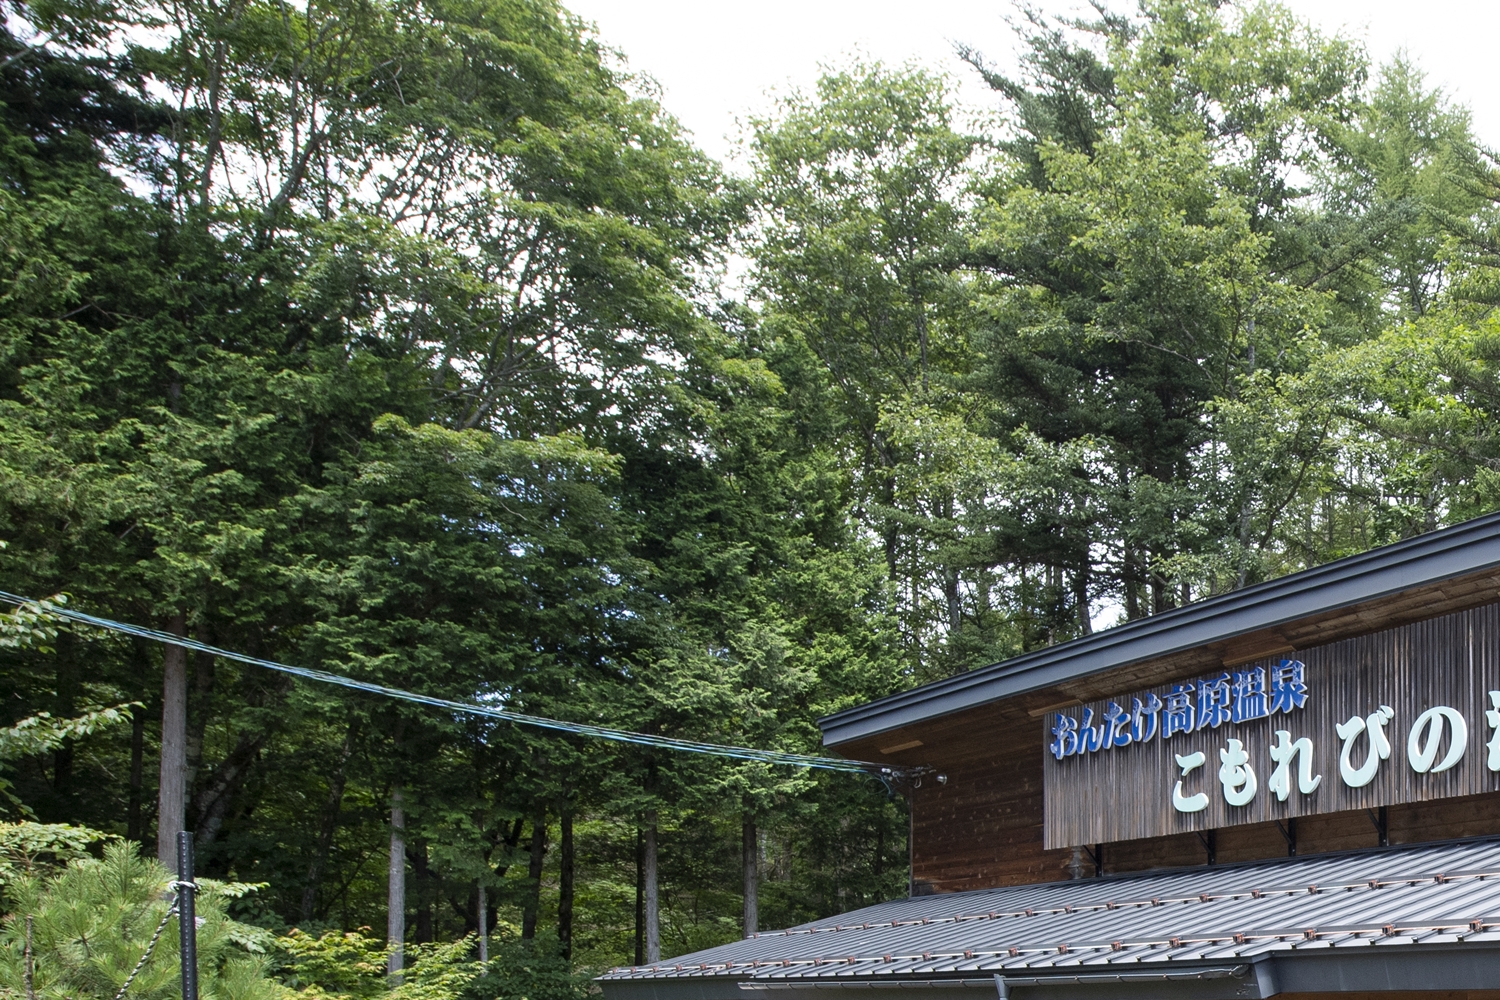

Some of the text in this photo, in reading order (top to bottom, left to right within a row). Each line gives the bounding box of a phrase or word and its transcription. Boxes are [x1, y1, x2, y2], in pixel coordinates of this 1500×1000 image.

[1050, 659, 1309, 760] おんたけ高原温泉
